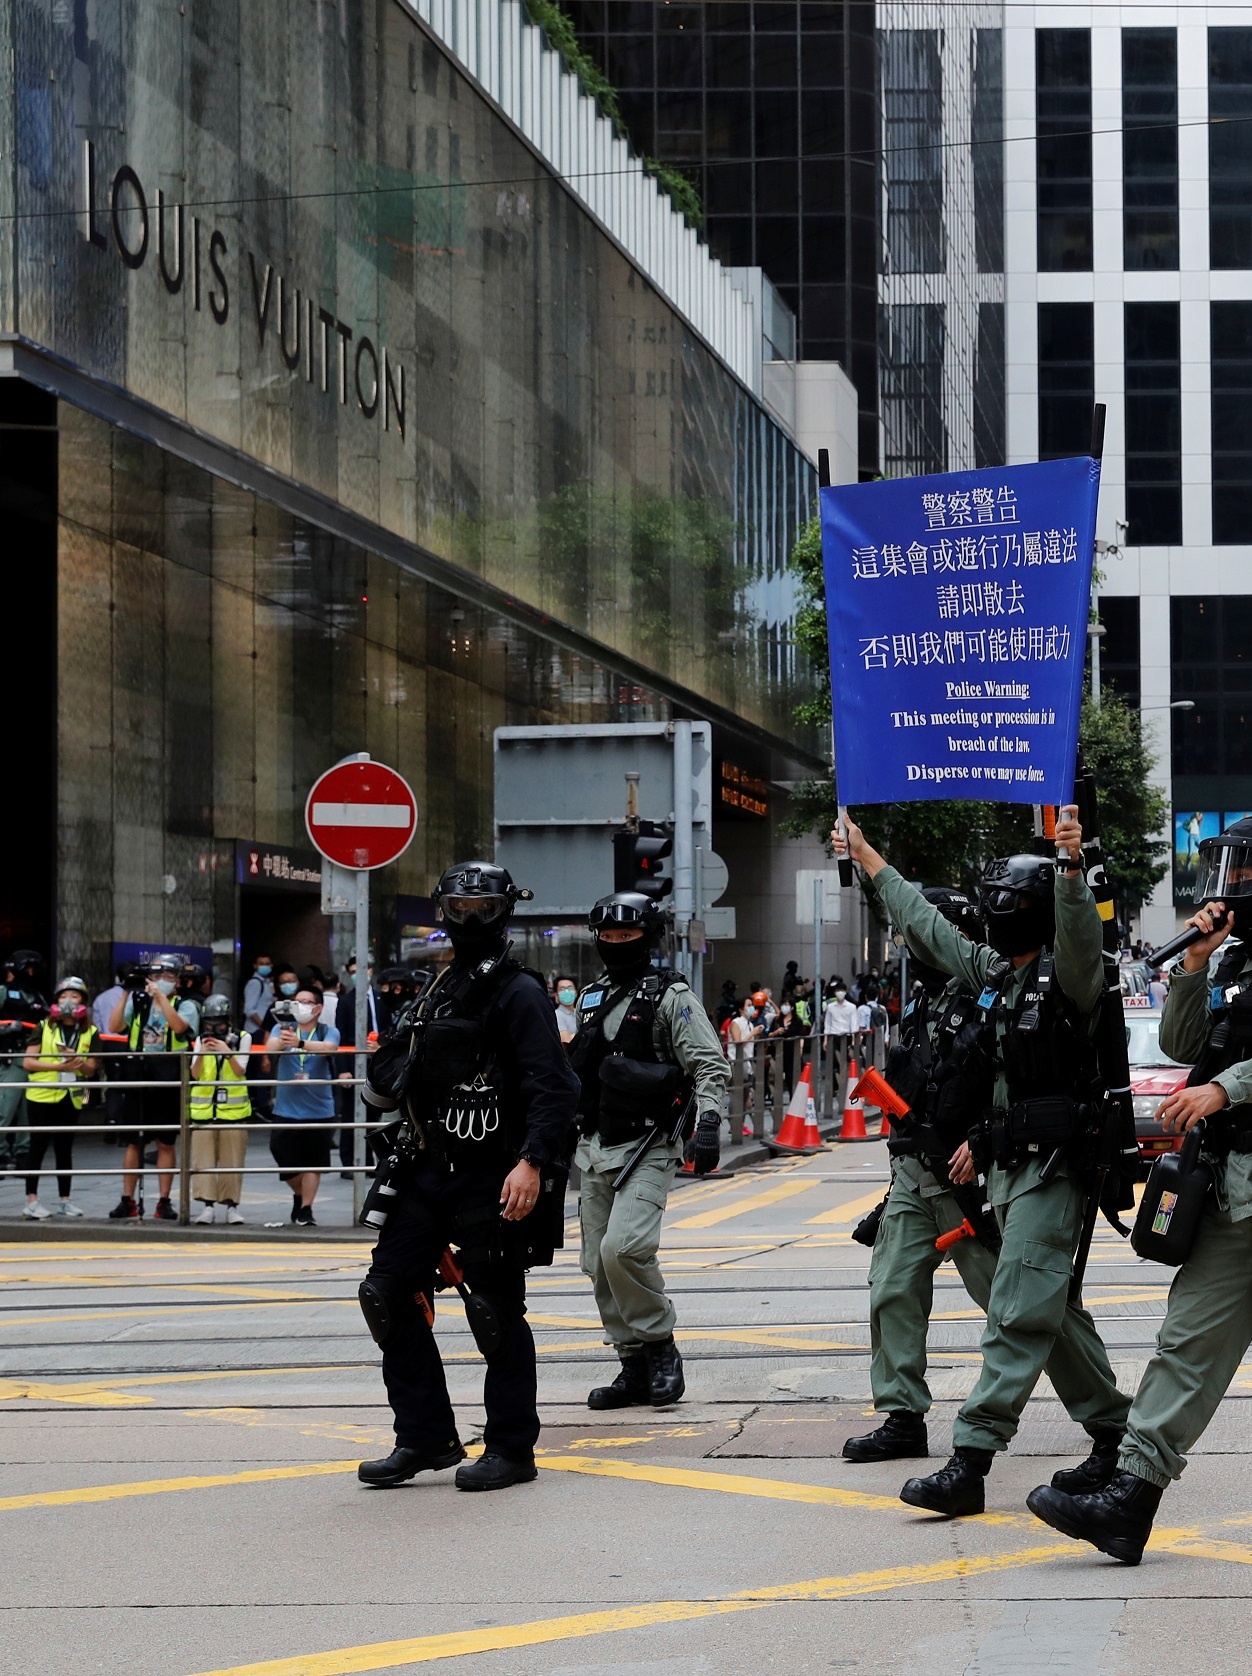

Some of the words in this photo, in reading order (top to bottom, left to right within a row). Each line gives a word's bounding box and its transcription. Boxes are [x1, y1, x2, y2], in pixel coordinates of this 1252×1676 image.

[84, 139, 229, 325] LOUIS
[248, 251, 406, 444] VUITTON
[921, 485, 1018, 528] 警察警告
[852, 527, 1078, 580] 這集會或遊行乃屬違法
[936, 580, 1026, 619] 請即散去
[858, 624, 1071, 670] 否則我們可能使用武力
[945, 681, 981, 697] Police
[984, 680, 1030, 700] Warning:
[891, 711, 927, 728] This
[930, 709, 978, 728] meeting
[981, 712, 992, 725] or
[995, 708, 1040, 728] procession
[1041, 708, 1048, 725] is
[1048, 708, 1055, 725] in
[948, 736, 986, 752] breach
[988, 736, 999, 752] of
[1000, 737, 1014, 752] the
[1015, 736, 1030, 753] law.
[907, 764, 969, 783] Disperse
[971, 766, 983, 779] or
[984, 767, 998, 779] we
[998, 768, 1014, 784] may
[1015, 768, 1027, 781] use
[1027, 765, 1044, 782] force.
[263, 853, 290, 879] 中環站
[1175, 887, 1197, 897] MAR
[1123, 998, 1148, 1006] TAXI
